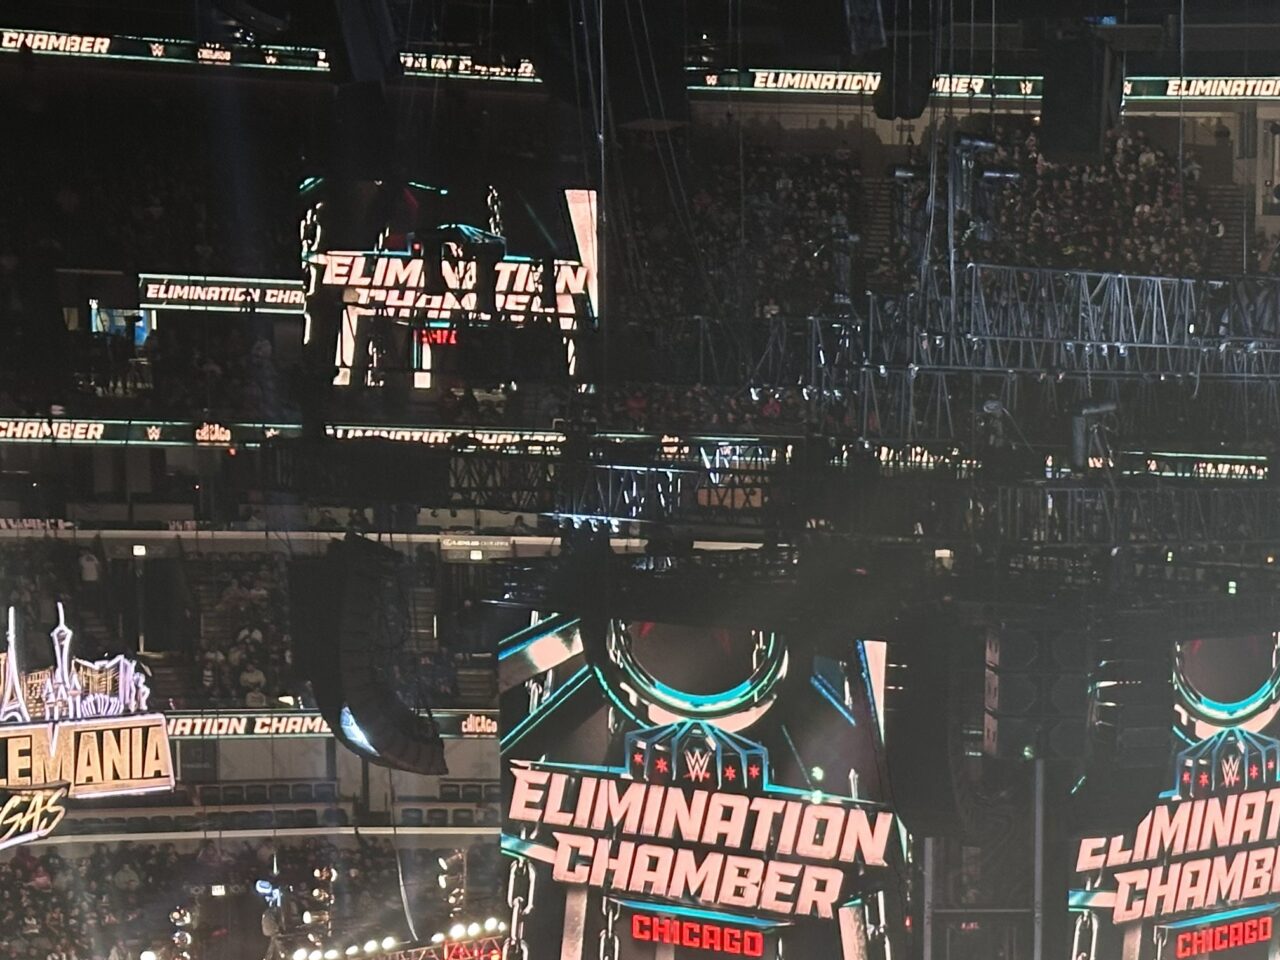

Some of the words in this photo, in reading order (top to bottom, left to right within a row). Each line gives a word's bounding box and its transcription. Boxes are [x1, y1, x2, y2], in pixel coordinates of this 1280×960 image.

[753, 72, 881, 91] ELIMINATION
[146, 284, 261, 303] ELIMINATION
[461, 714, 498, 734] CHICAGO
[508, 766, 893, 868] ELIMINATION
[552, 831, 844, 919] CHAMBER
[631, 914, 765, 958] CHICAGO
[1176, 916, 1273, 960] CHICAGO
